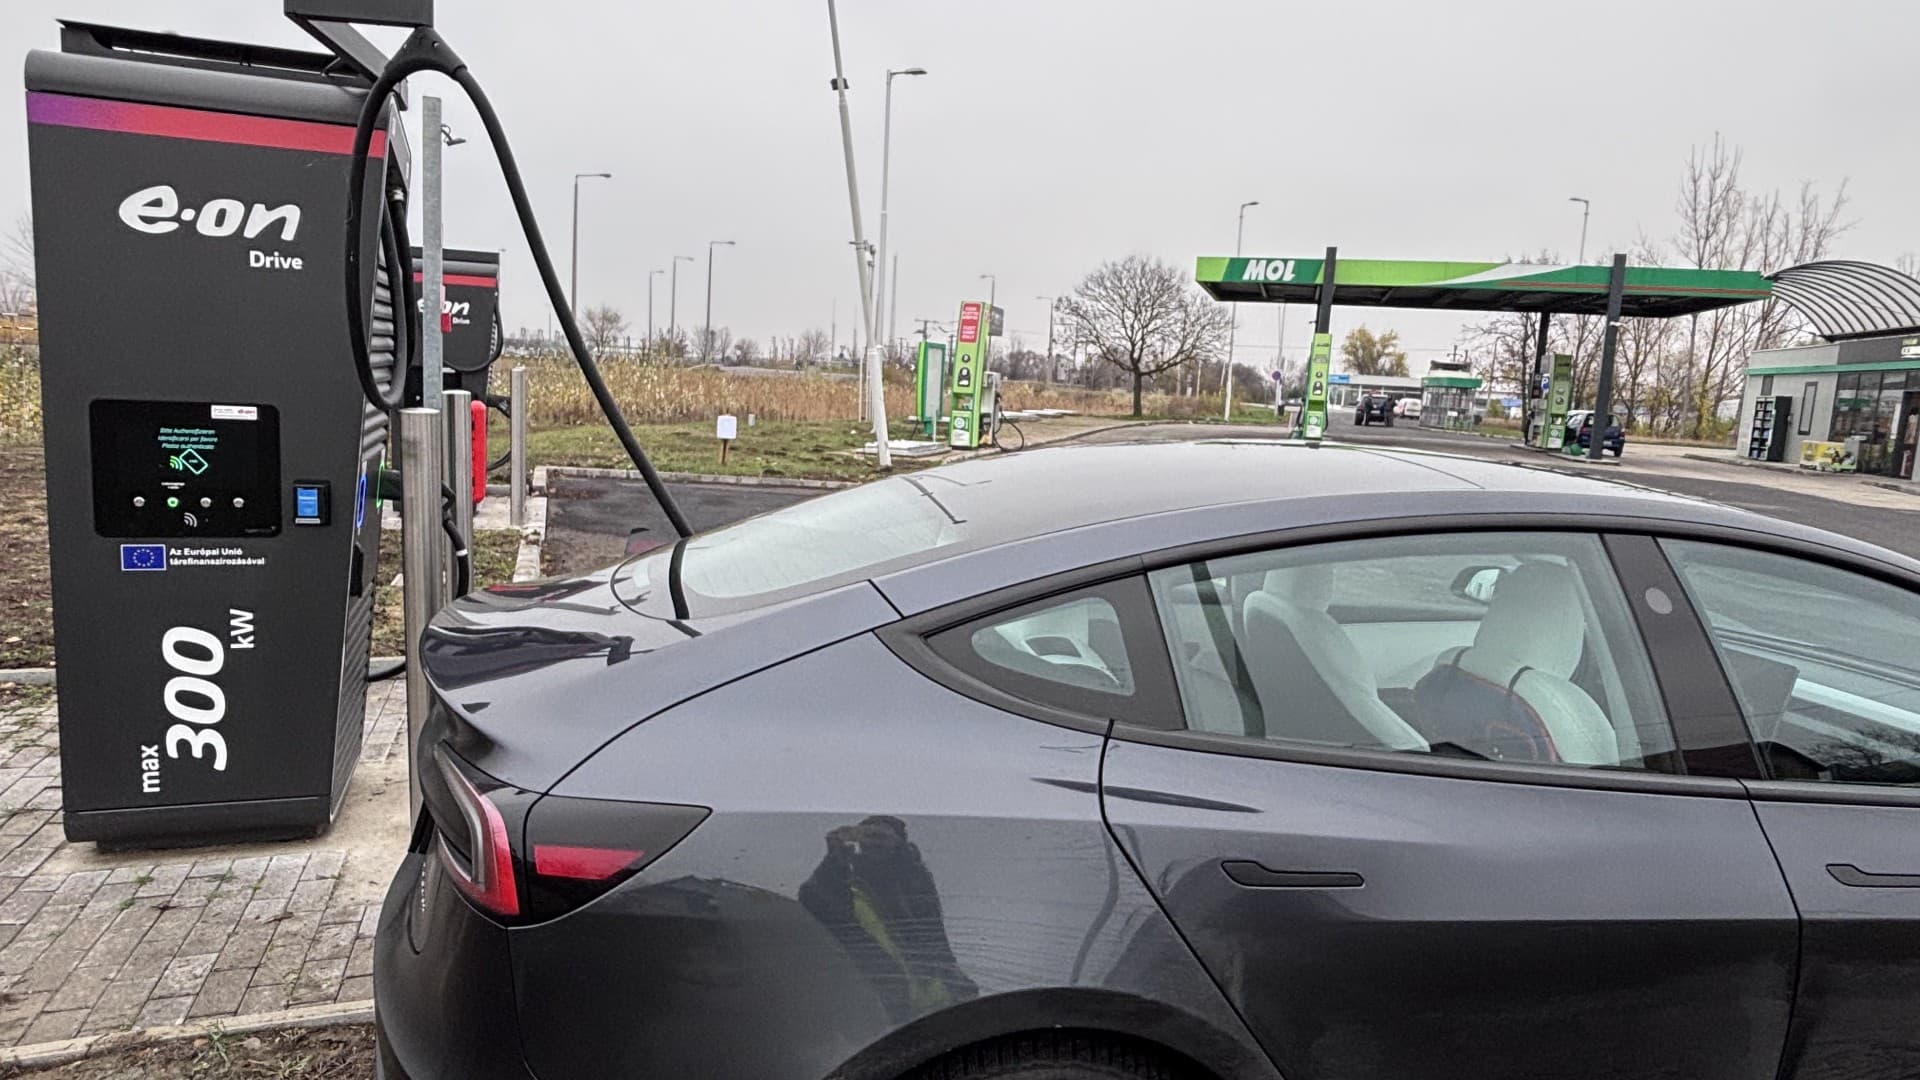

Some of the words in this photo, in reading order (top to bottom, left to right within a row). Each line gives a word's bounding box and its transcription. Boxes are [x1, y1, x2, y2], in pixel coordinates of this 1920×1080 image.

[249, 250, 303, 270] Drive
[1242, 259, 1296, 281] MOL
[169, 547, 182, 556] Az
[183, 547, 220, 557] Európai
[221, 547, 243, 556] Unió
[229, 608, 255, 649] kW
[161, 626, 228, 772] 300
[140, 744, 161, 793] max
